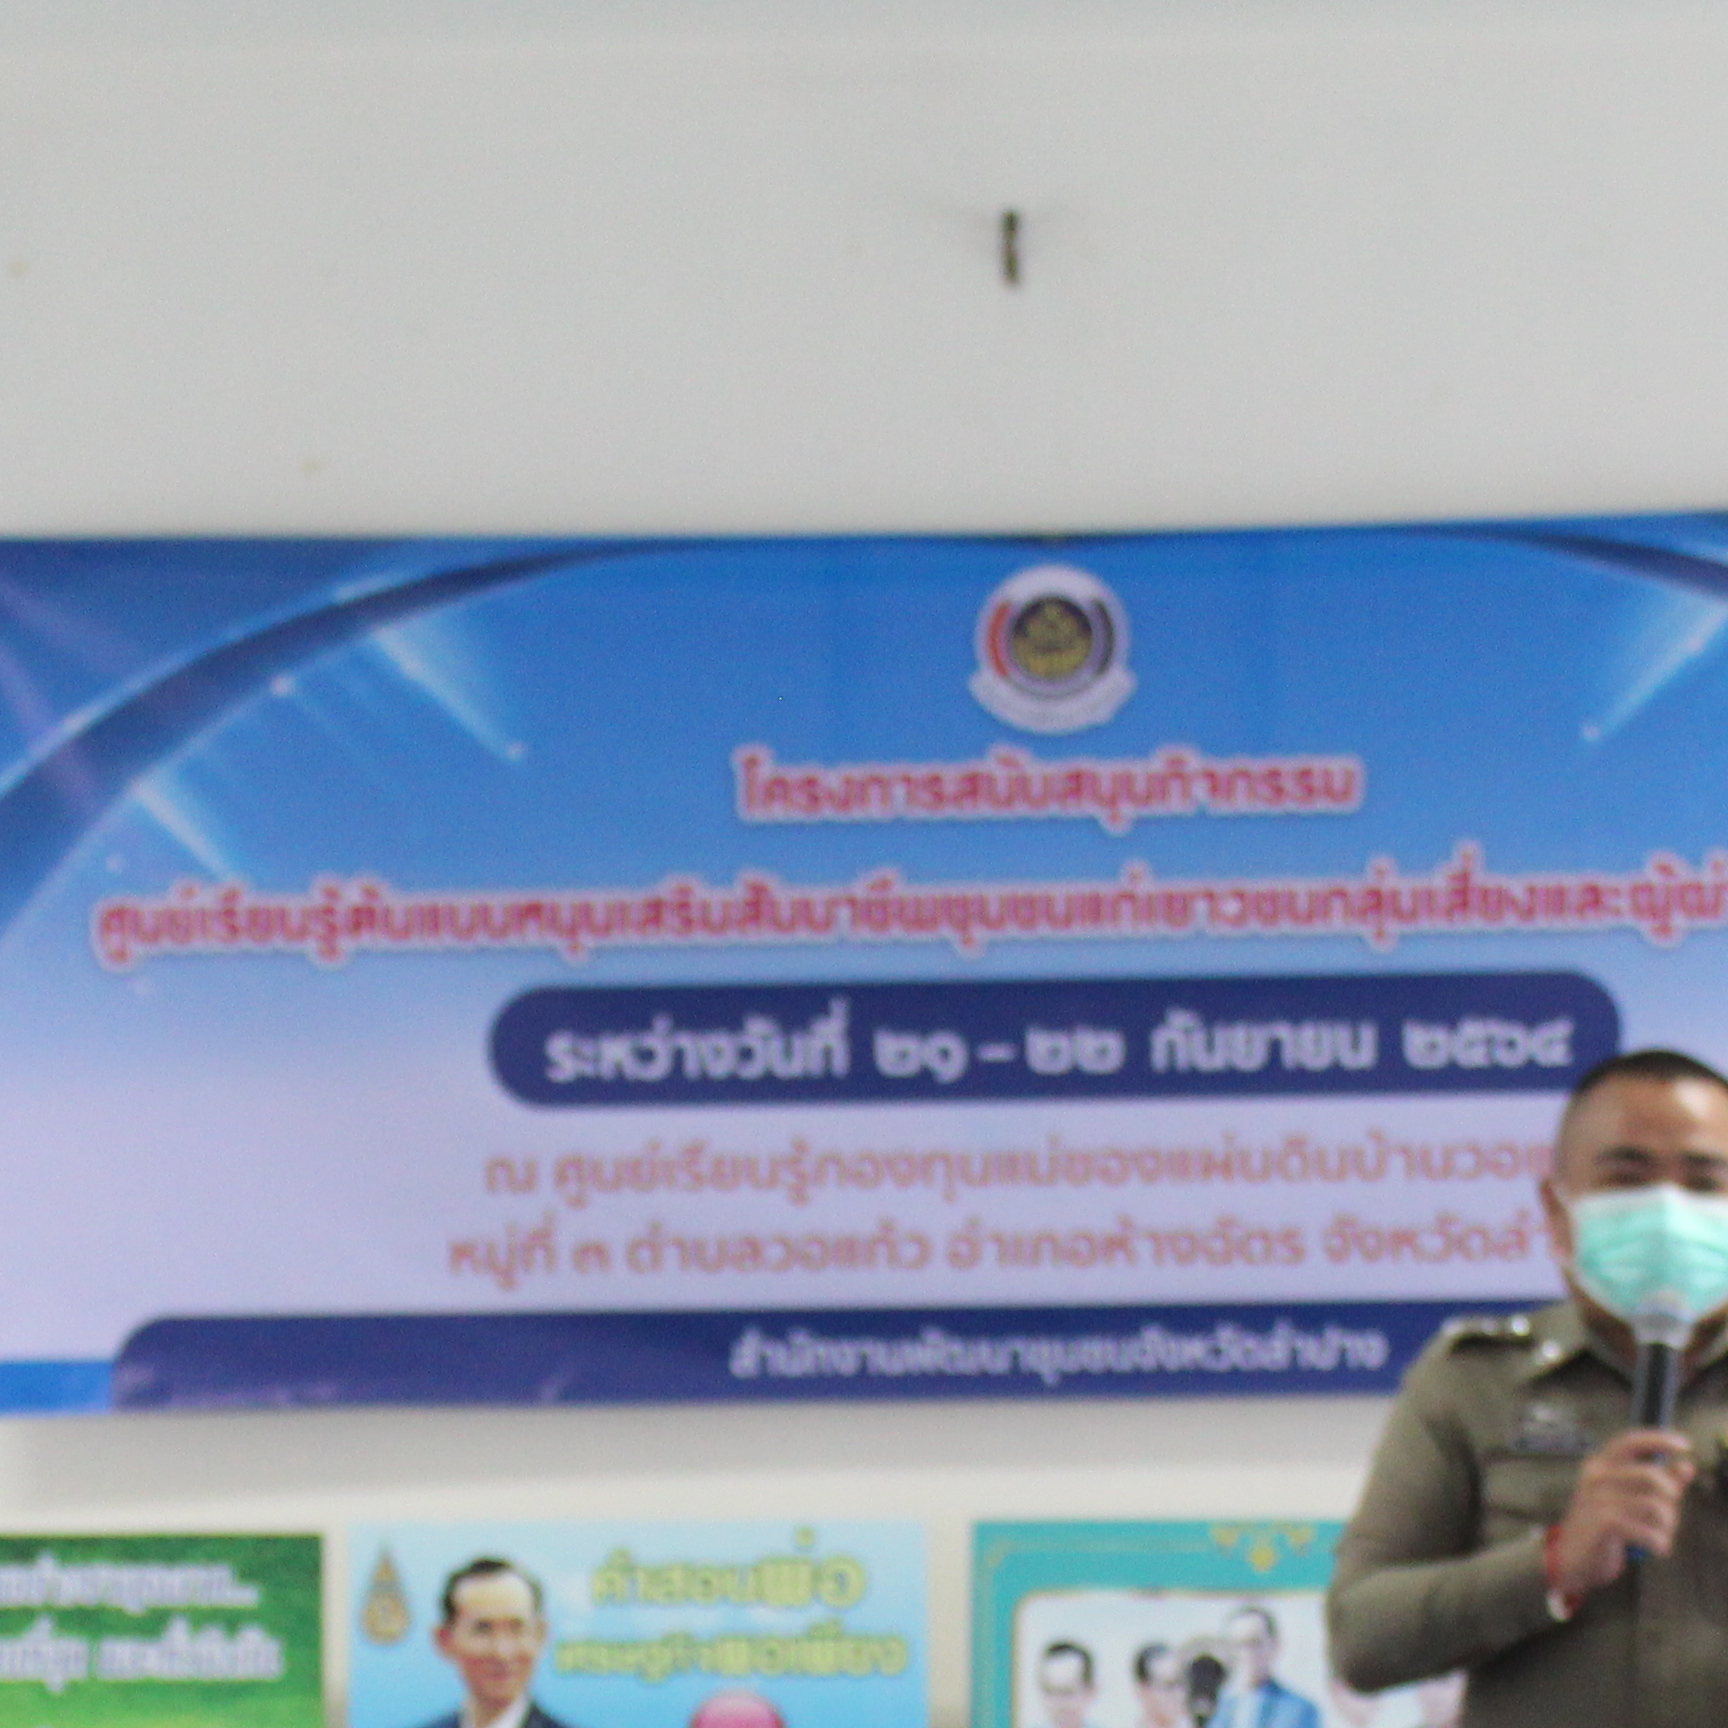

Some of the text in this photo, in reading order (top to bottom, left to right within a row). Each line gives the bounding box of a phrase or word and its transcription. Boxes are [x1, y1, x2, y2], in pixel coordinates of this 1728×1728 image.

[735, 746, 1364, 833] โครงการสนับสนุนกิจกรรม
[544, 996, 852, 1083] ระหว่างวันที่
[874, 1031, 970, 1084] ๒๑
[1025, 1026, 1127, 1075] ๒๒
[1150, 1006, 1379, 1073] กันยายน
[483, 1128, 1560, 1209] ณ ศูนย์เรียนรู้กองทุนแม่ของแผ่นดินบ้านวอแ
[447, 1208, 1566, 1290] หมู่ที่ ๓ ตำบลวอแก้ว อำเภอห้างฉัตร จังหวัดลำ
[728, 1320, 1390, 1388] สำนักงานพัฒนาชุมชนจังหวัดลำปาง
